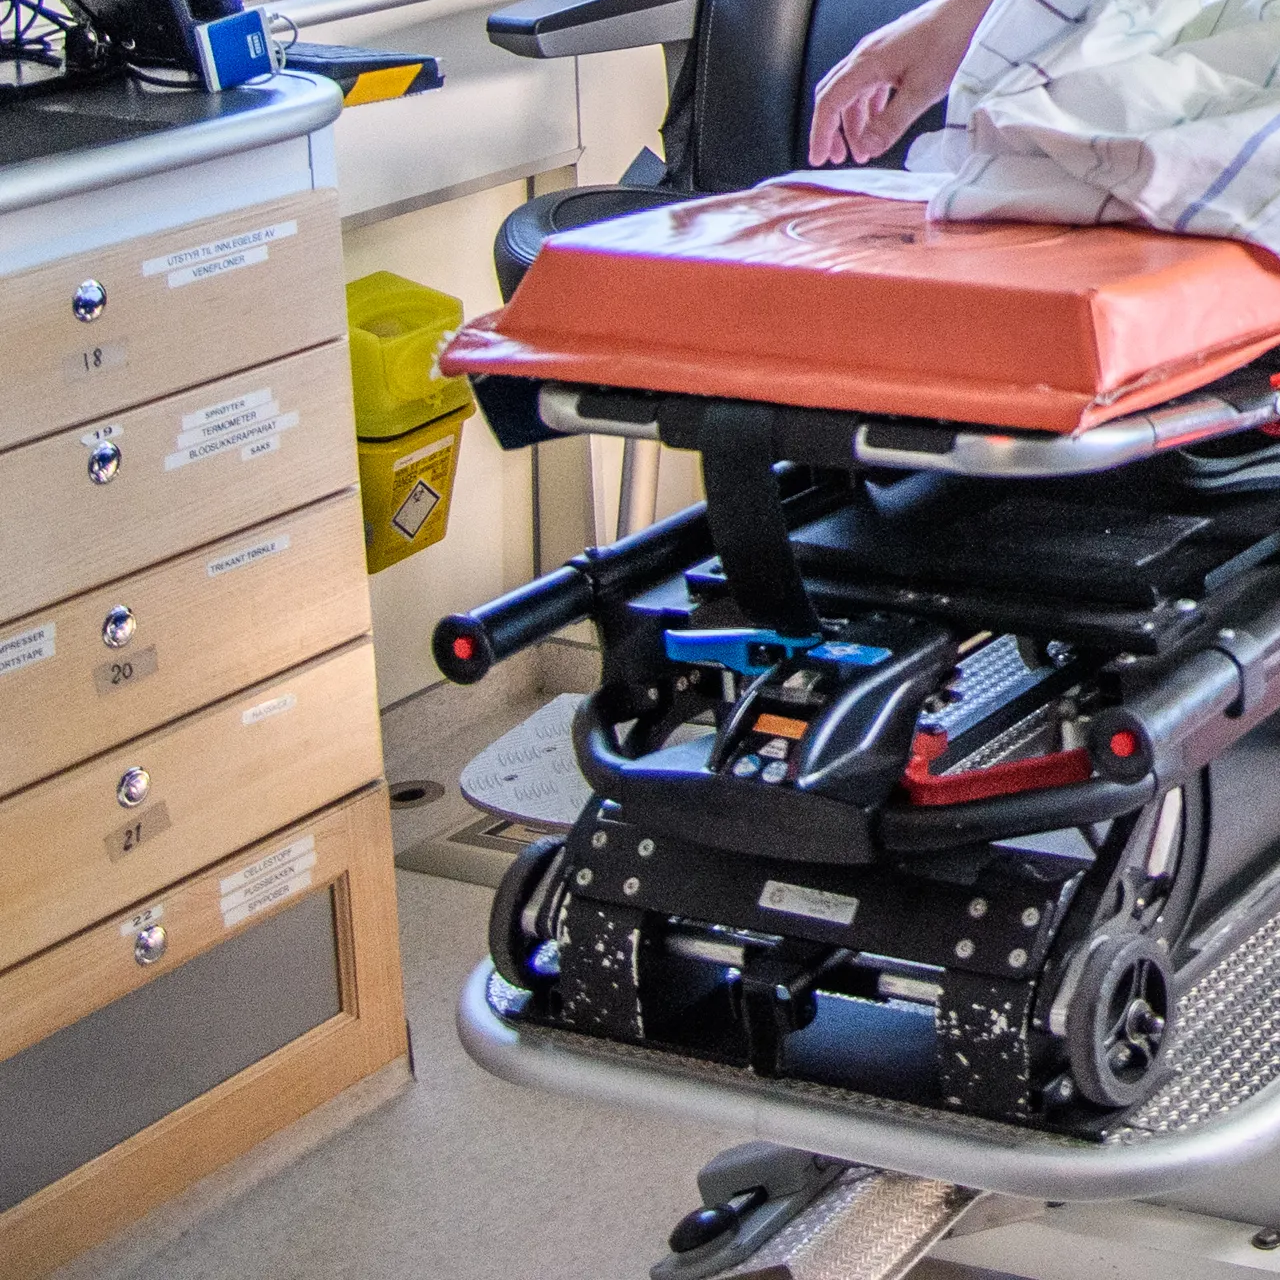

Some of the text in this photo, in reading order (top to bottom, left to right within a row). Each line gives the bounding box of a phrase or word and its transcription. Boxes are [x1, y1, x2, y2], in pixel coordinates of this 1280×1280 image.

[167, 228, 276, 266] UTSTYR TIL INNLEGELSE AV
[192, 255, 246, 277] VENEFLONER
[83, 348, 102, 371] 18
[205, 400, 245, 419] SPRØYTER
[202, 411, 257, 436] TERMOMETER
[188, 421, 277, 459] BLODSUKKERAPPARAT
[250, 442, 271, 455] SAKS
[210, 554, 245, 573] TREKANT
[111, 662, 133, 685] 20
[123, 822, 142, 851] 21
[132, 909, 152, 927] 22
